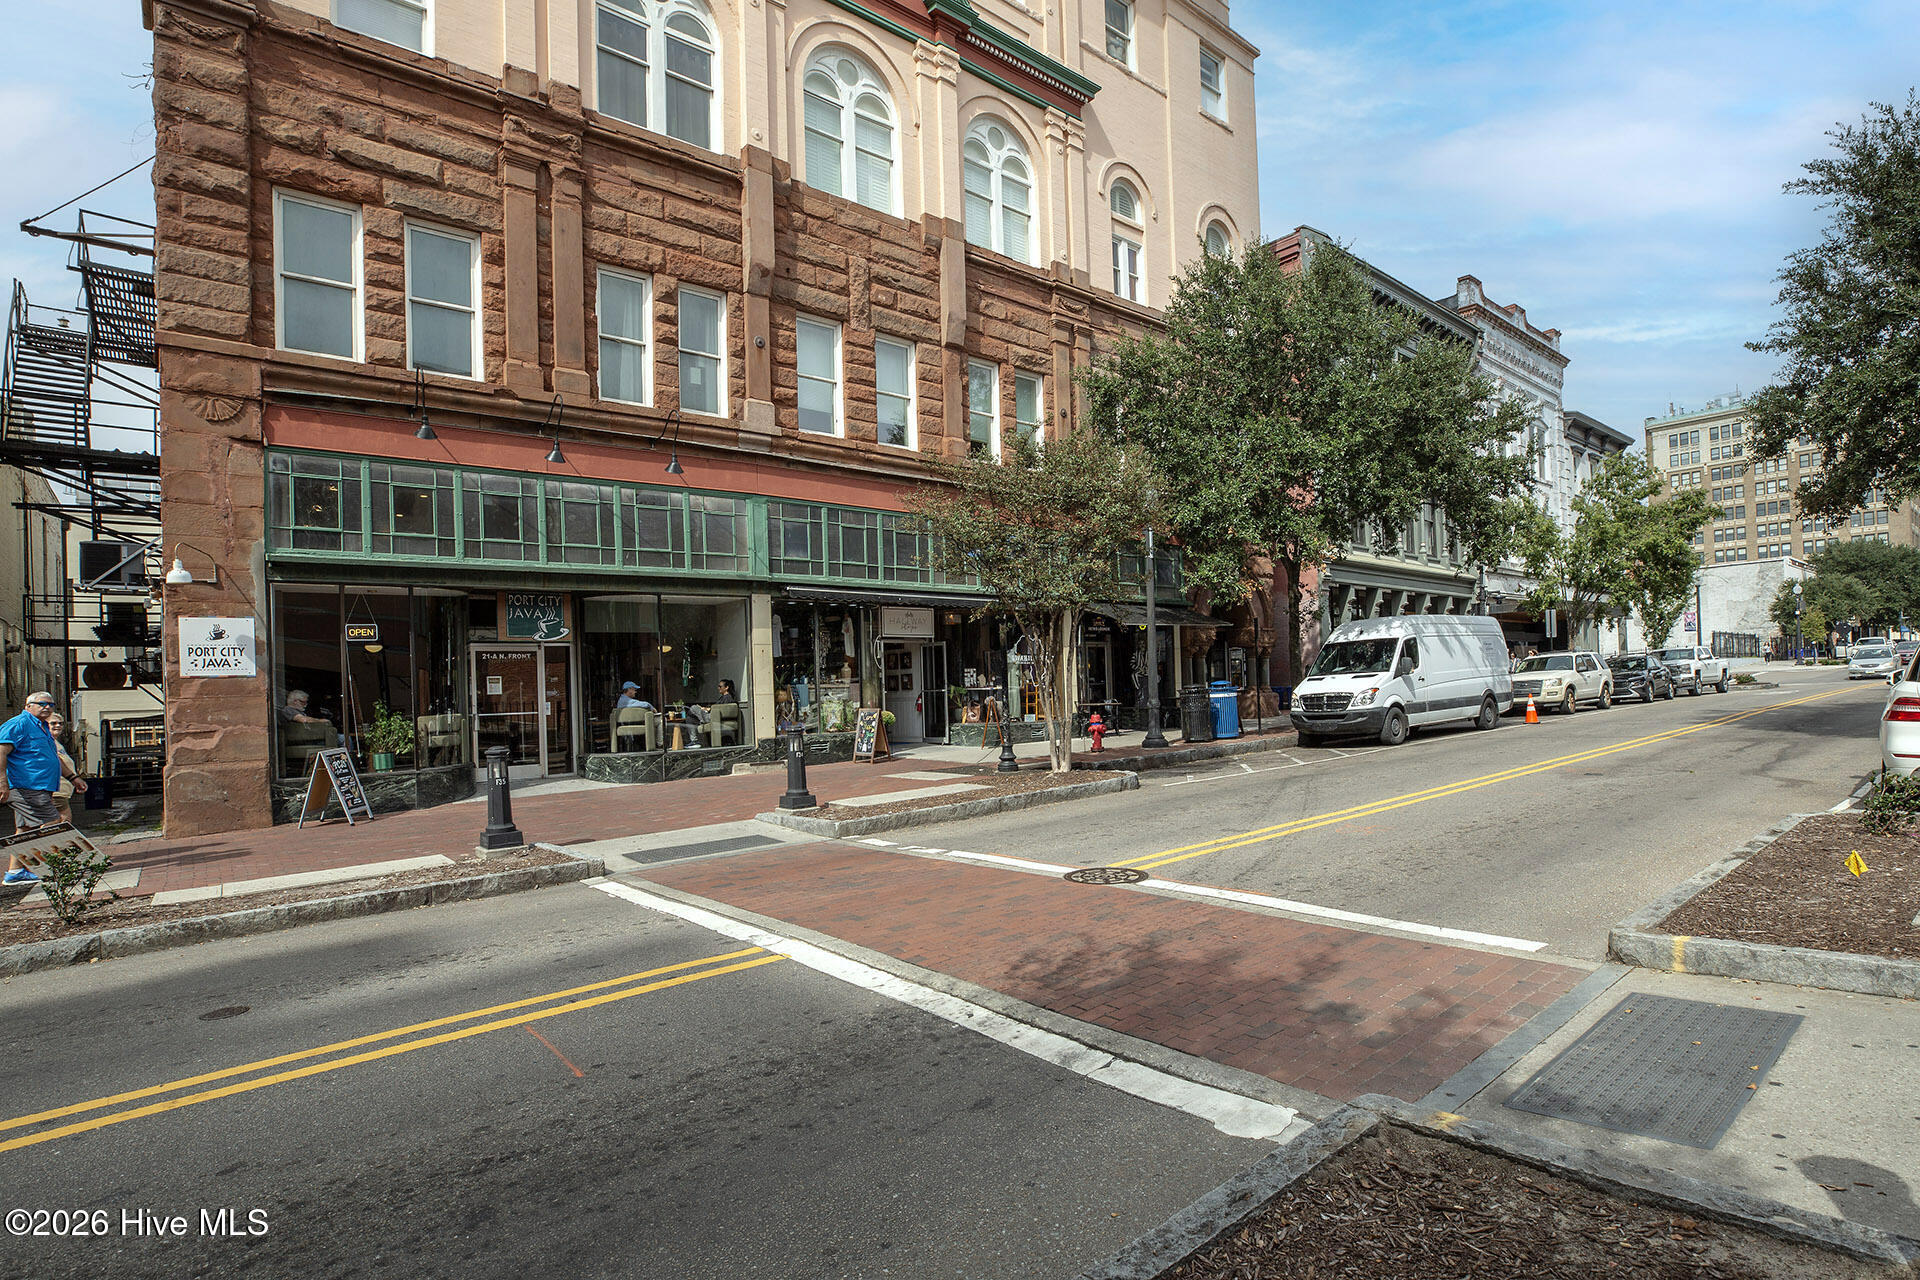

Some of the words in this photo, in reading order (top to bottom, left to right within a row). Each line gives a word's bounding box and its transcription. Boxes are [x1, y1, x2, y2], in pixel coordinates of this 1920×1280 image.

[508, 594, 535, 606] PORT
[538, 595, 561, 607] CITY
[509, 608, 543, 618] JAVA
[348, 628, 374, 637] OPEN
[188, 647, 216, 656] PORT
[220, 647, 245, 656] CITY
[202, 658, 231, 668] JAVA
